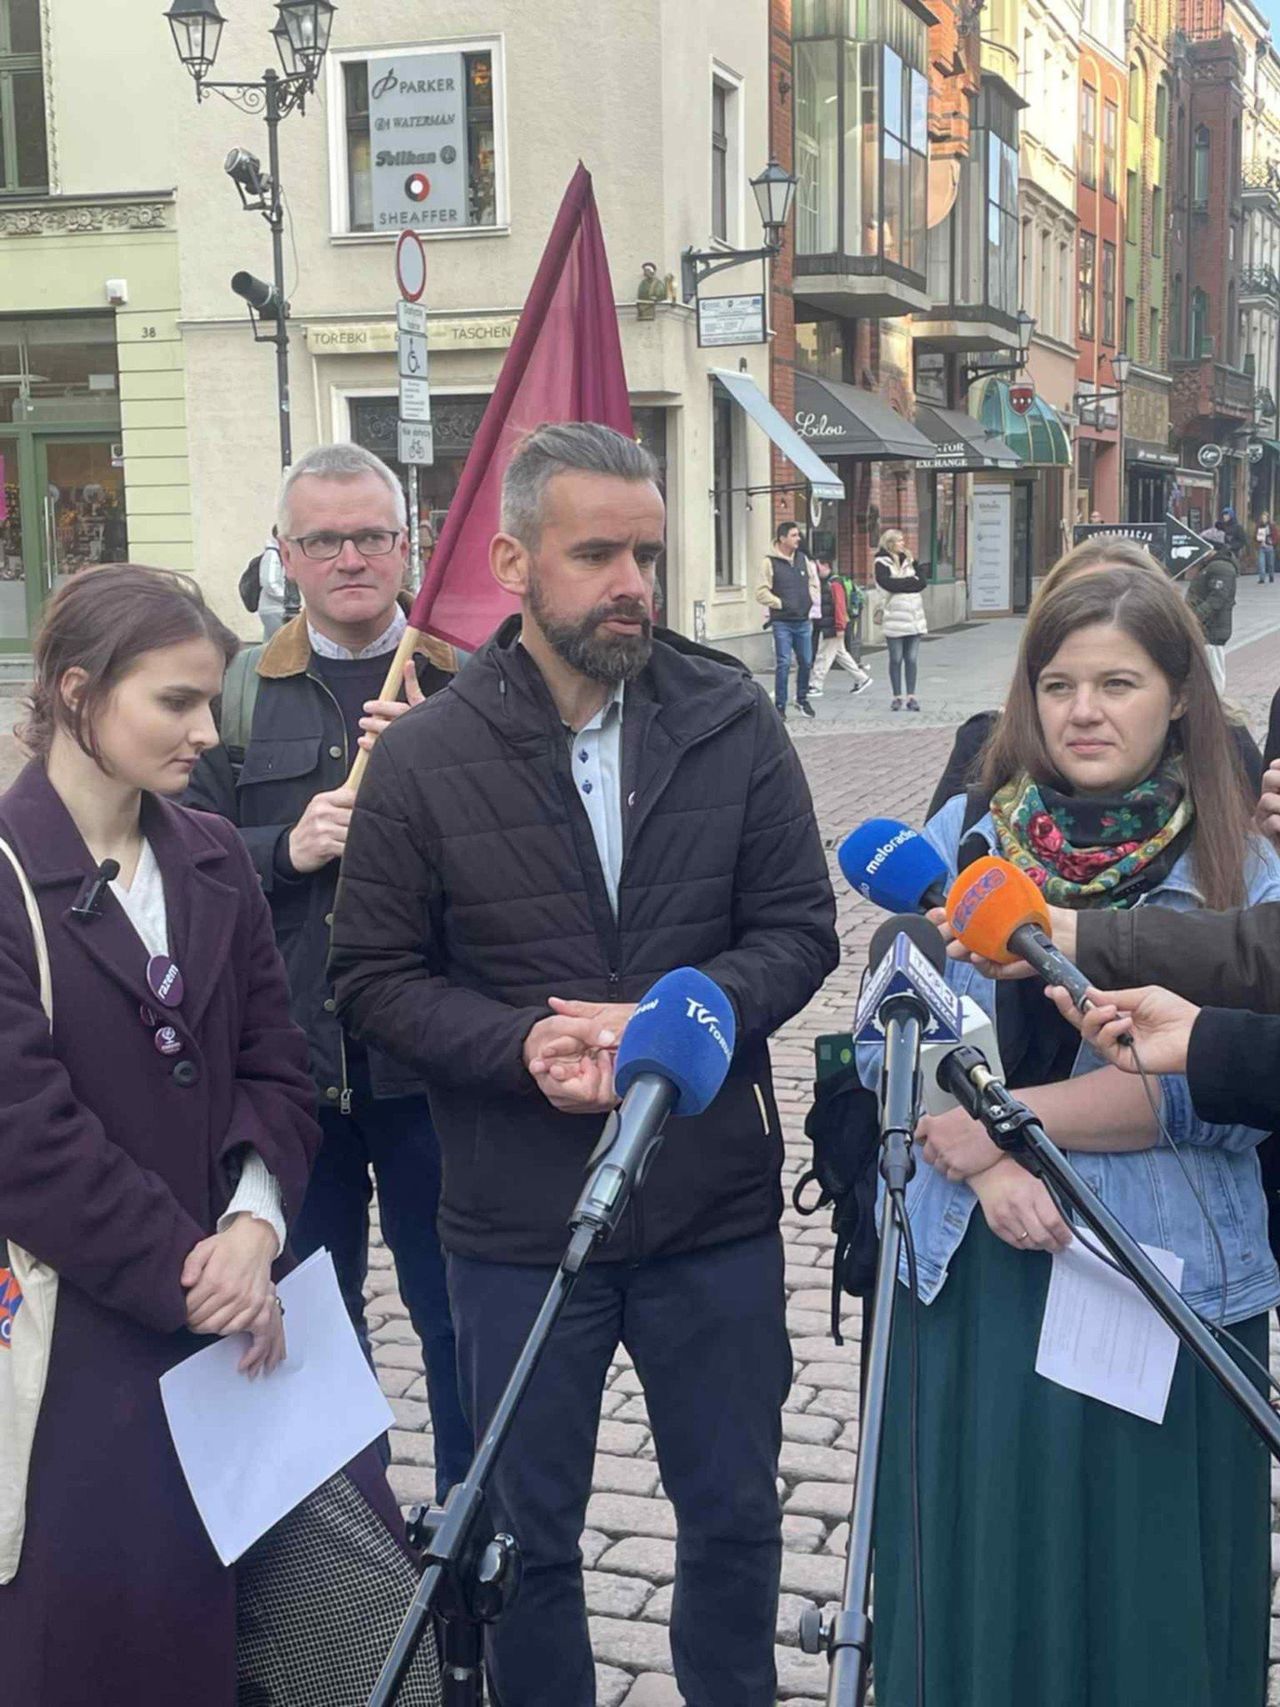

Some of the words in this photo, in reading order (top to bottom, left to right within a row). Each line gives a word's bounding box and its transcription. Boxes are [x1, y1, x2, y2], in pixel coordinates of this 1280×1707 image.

[399, 78, 455, 94] PARKER
[392, 113, 456, 128] WATERMAN
[379, 209, 458, 225] SHEAFFER
[141, 326, 157, 339] 38
[313, 332, 367, 345] TOREBKI
[451, 326, 512, 340] TASCHEN
[795, 411, 847, 438] Lilou
[915, 458, 968, 469] EXCHANGE
[158, 964, 179, 999] razem
